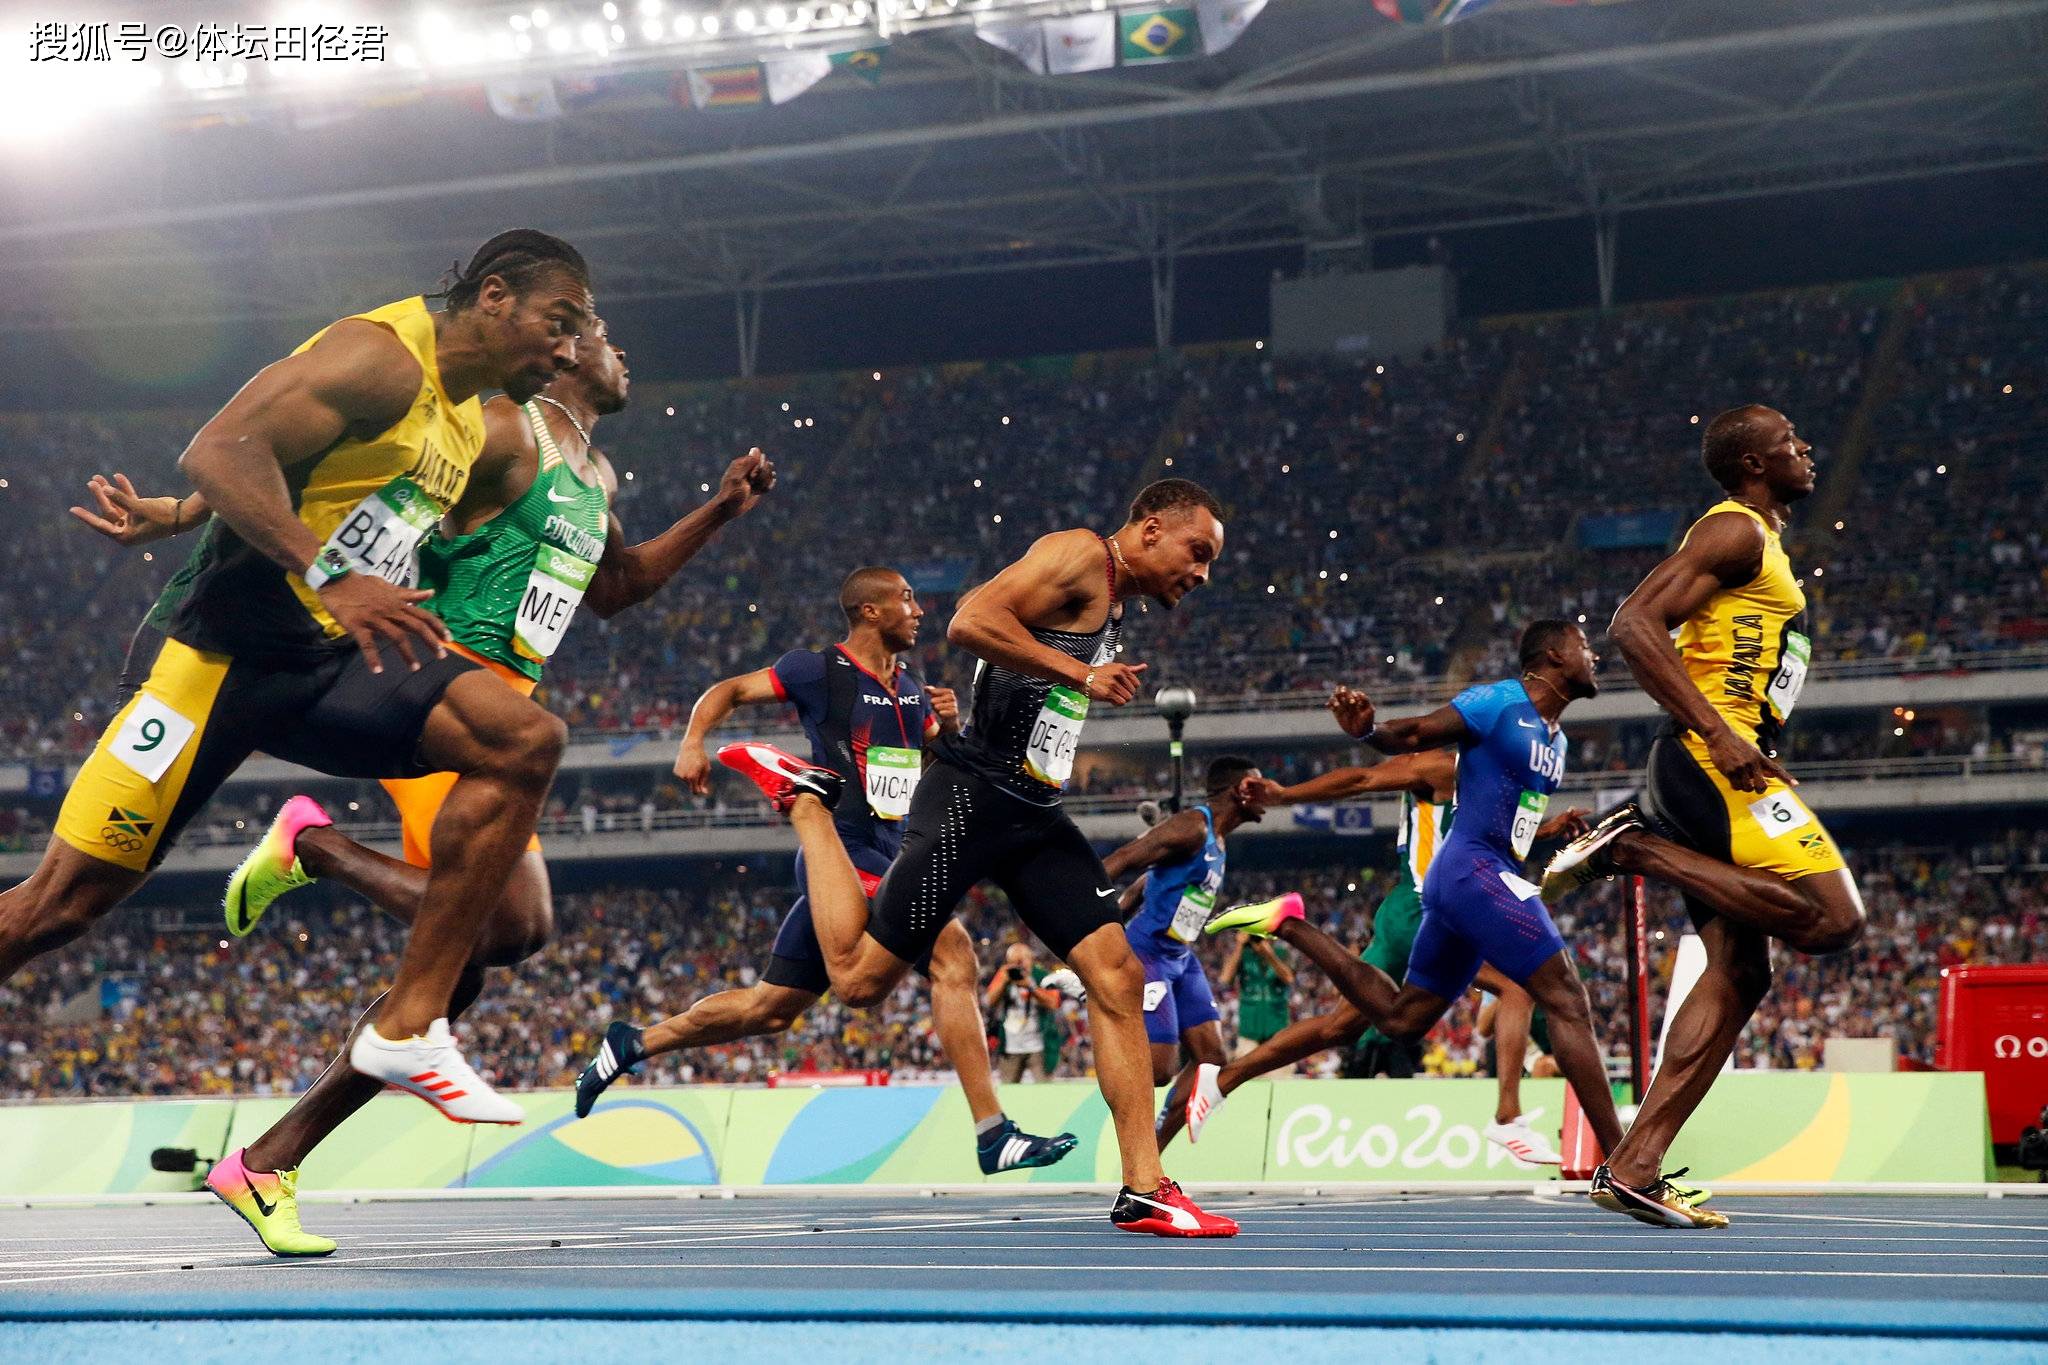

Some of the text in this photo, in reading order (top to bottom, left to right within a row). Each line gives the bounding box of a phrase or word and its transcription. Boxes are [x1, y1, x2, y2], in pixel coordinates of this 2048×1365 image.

[1723, 614, 1764, 702] JAMAICA
[862, 694, 921, 707] FRANCE
[132, 718, 166, 752] 9
[1031, 720, 1058, 754] DE
[1529, 739, 1564, 790] USA
[1771, 801, 1792, 823] 6
